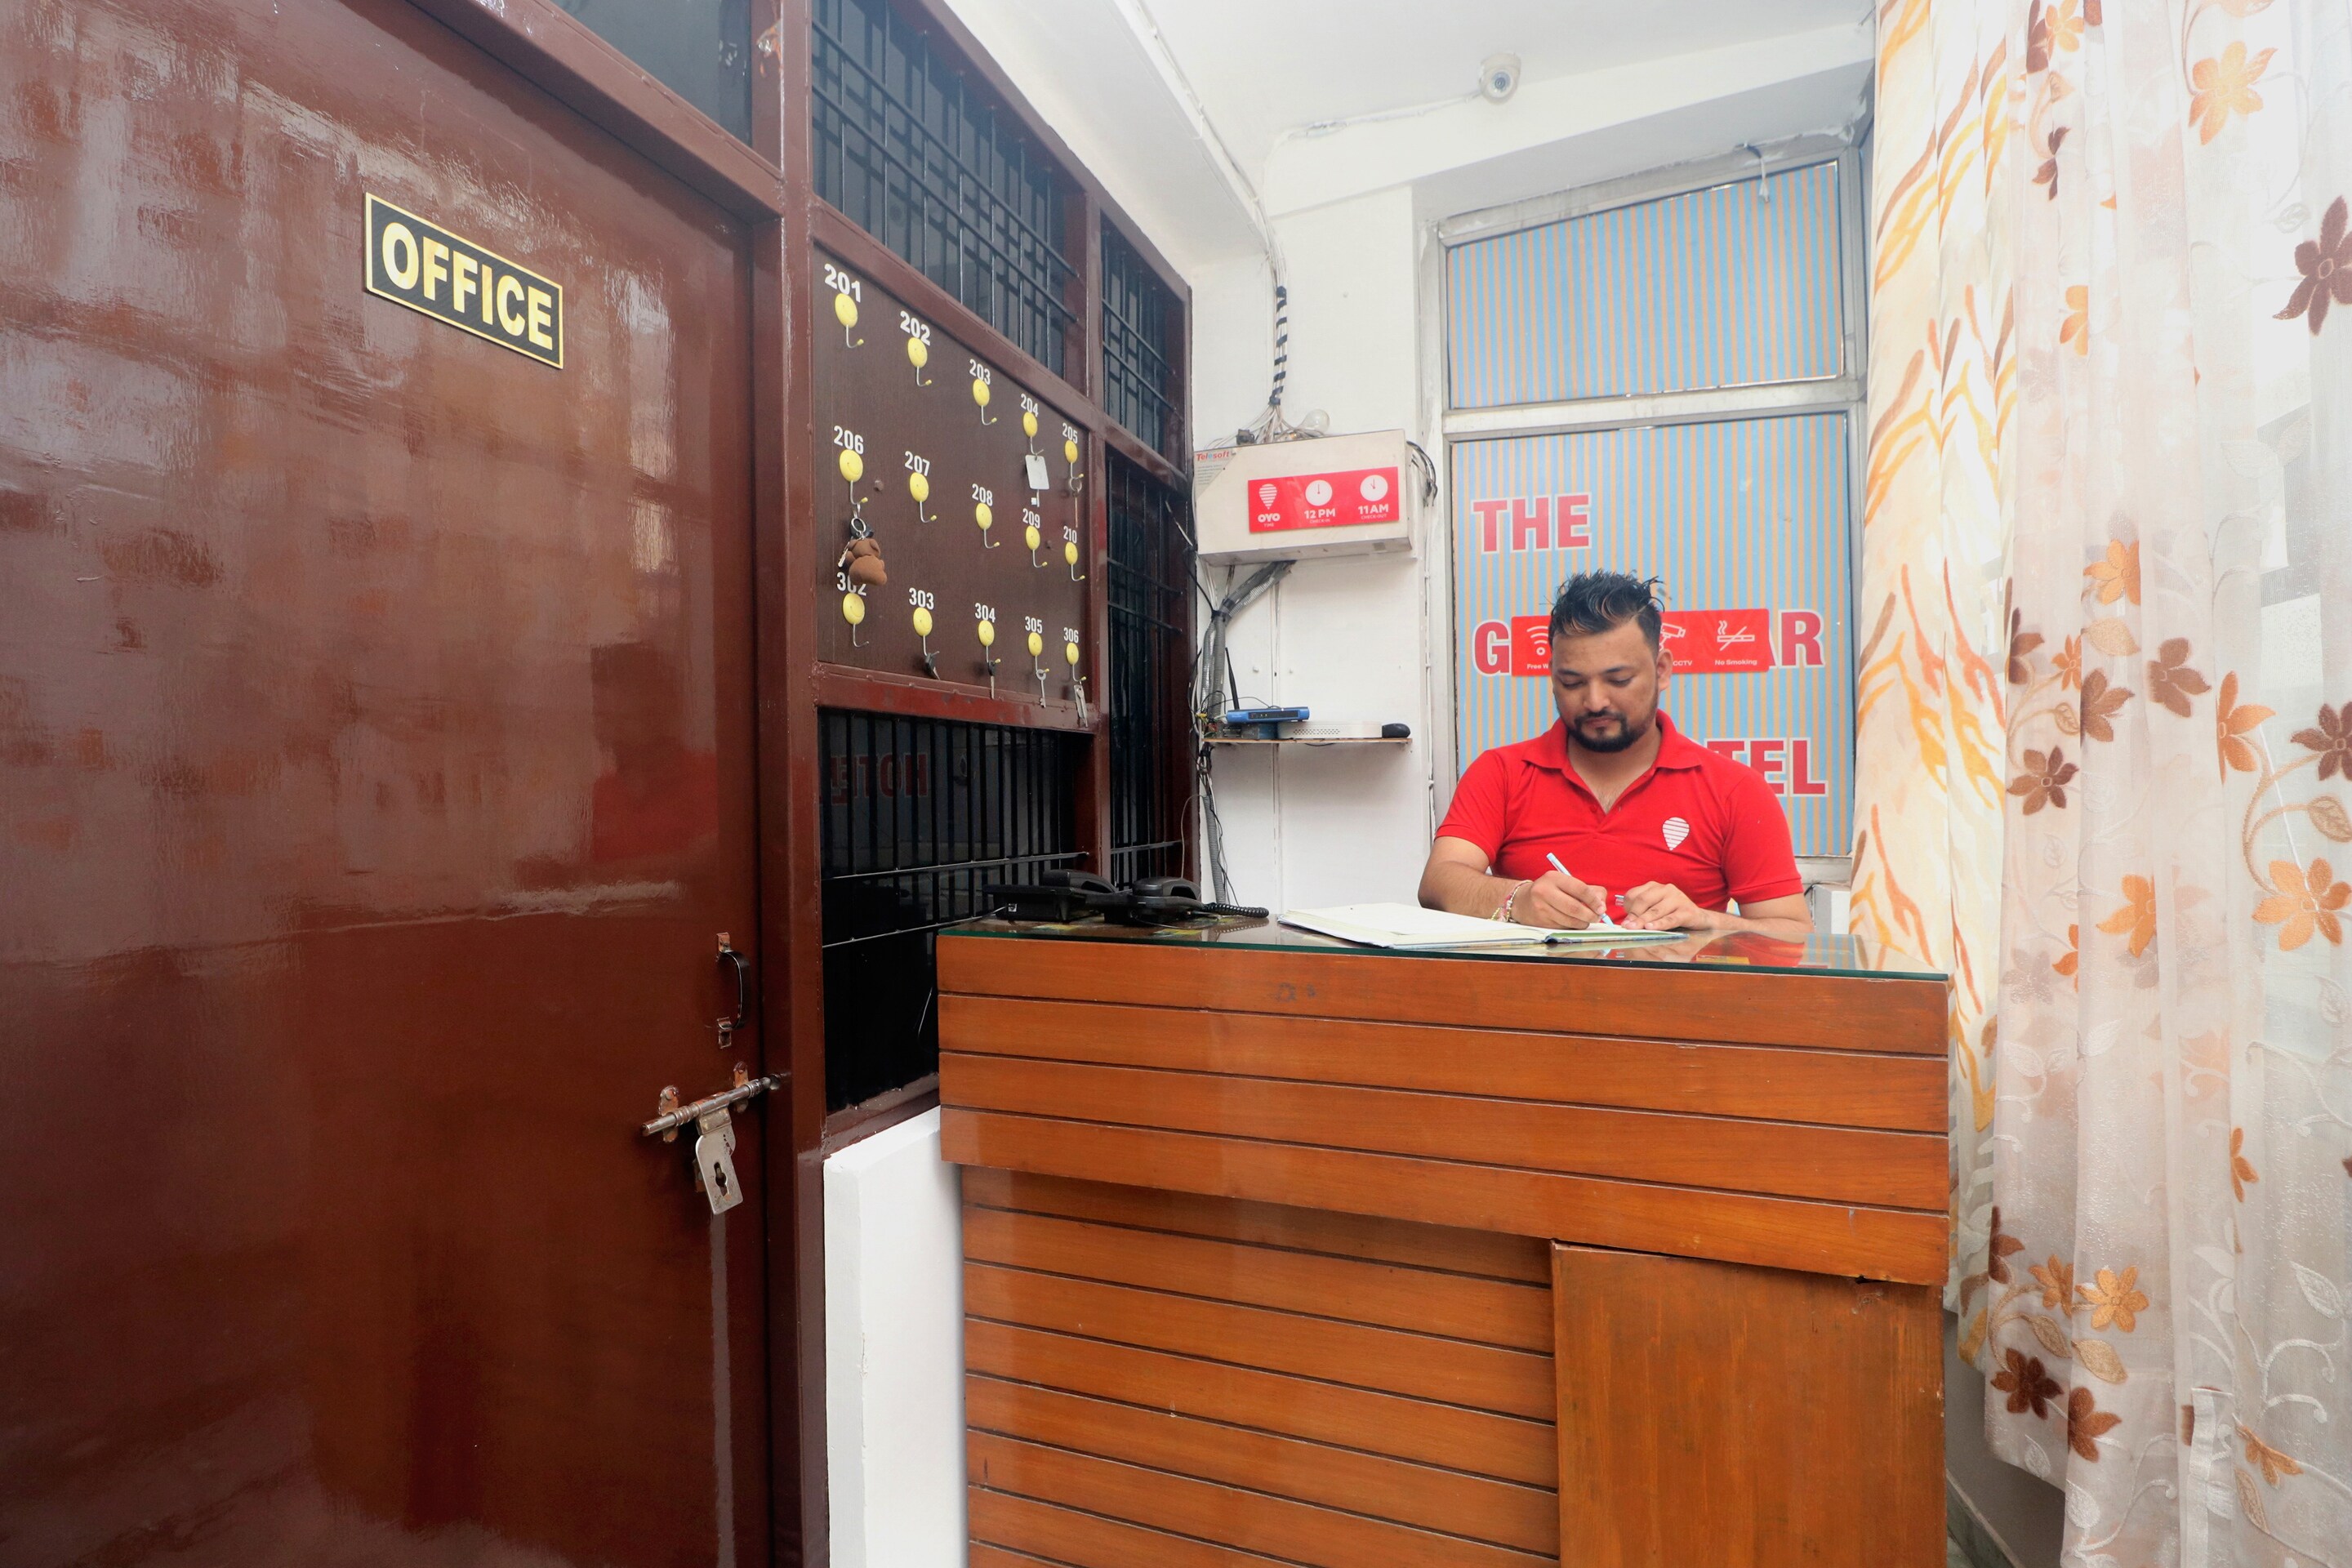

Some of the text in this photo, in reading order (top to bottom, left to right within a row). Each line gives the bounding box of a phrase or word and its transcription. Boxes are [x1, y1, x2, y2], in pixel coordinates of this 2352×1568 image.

[382, 222, 552, 350] OFFICE
[824, 264, 861, 302] 201
[900, 310, 931, 345] 202
[969, 359, 991, 385] 203
[1021, 394, 1039, 416] 204
[834, 425, 864, 455] 206
[1062, 422, 1078, 444] 205
[905, 451, 930, 476] 207
[972, 483, 993, 506] 208
[1022, 508, 1040, 528] 209
[1258, 513, 1281, 522] OYO
[1304, 508, 1336, 519] 12 PM
[1358, 504, 1388, 515] 11 AM
[1472, 492, 1591, 555] THE
[1063, 526, 1077, 544] 210
[909, 587, 934, 610] 303
[975, 603, 996, 623] 304
[1025, 616, 1042, 634] 305
[1063, 627, 1079, 644] 306
